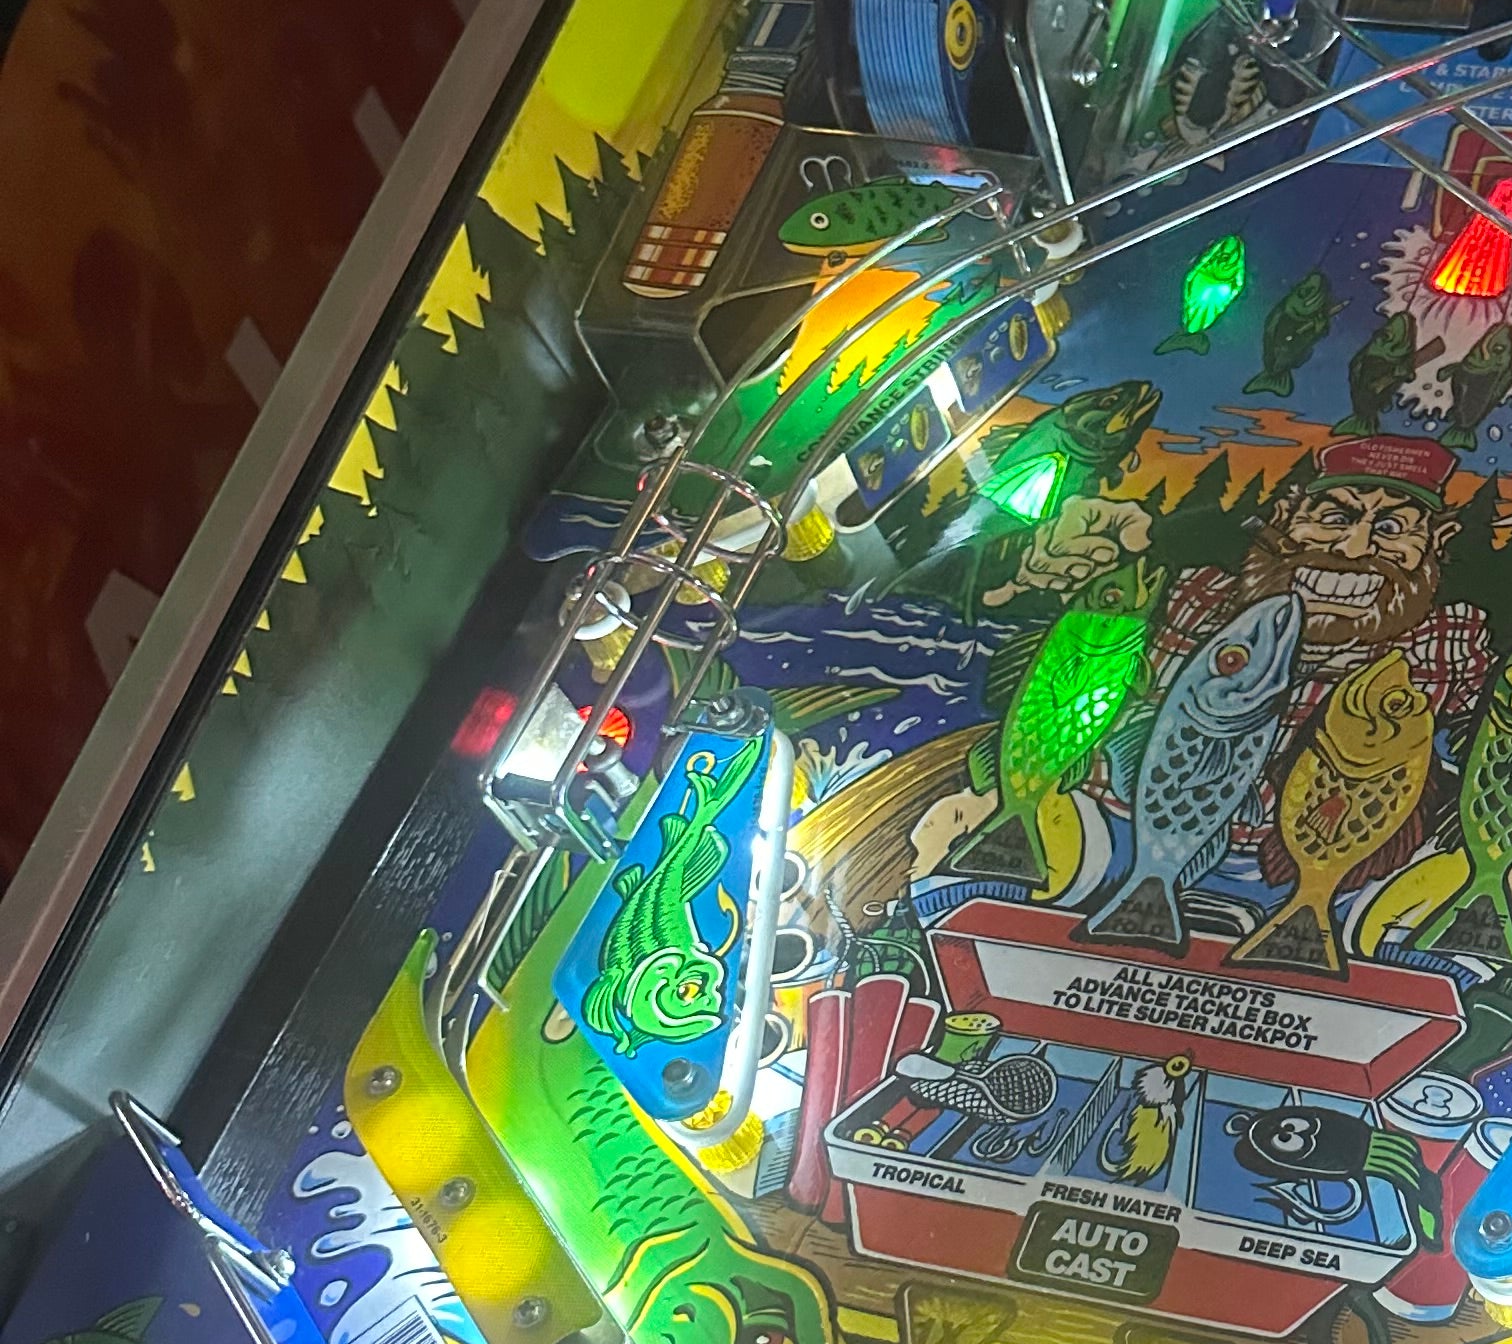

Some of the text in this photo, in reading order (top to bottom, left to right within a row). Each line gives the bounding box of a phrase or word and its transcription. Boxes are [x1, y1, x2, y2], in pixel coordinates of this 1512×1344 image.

[1066, 976, 1313, 1033] ADVANCE TACKLE BOX
[1113, 967, 1276, 1008] ALL JACKPOTS
[1052, 990, 1318, 1052] TO LITE SUPER JACKPOT
[872, 1162, 966, 1195] TROPICAL
[1040, 1182, 1182, 1223] FRESH WATER
[1051, 1219, 1149, 1256] AUTO
[1238, 1236, 1341, 1271] DEEP SEA
[1045, 1249, 1136, 1287] CAST
